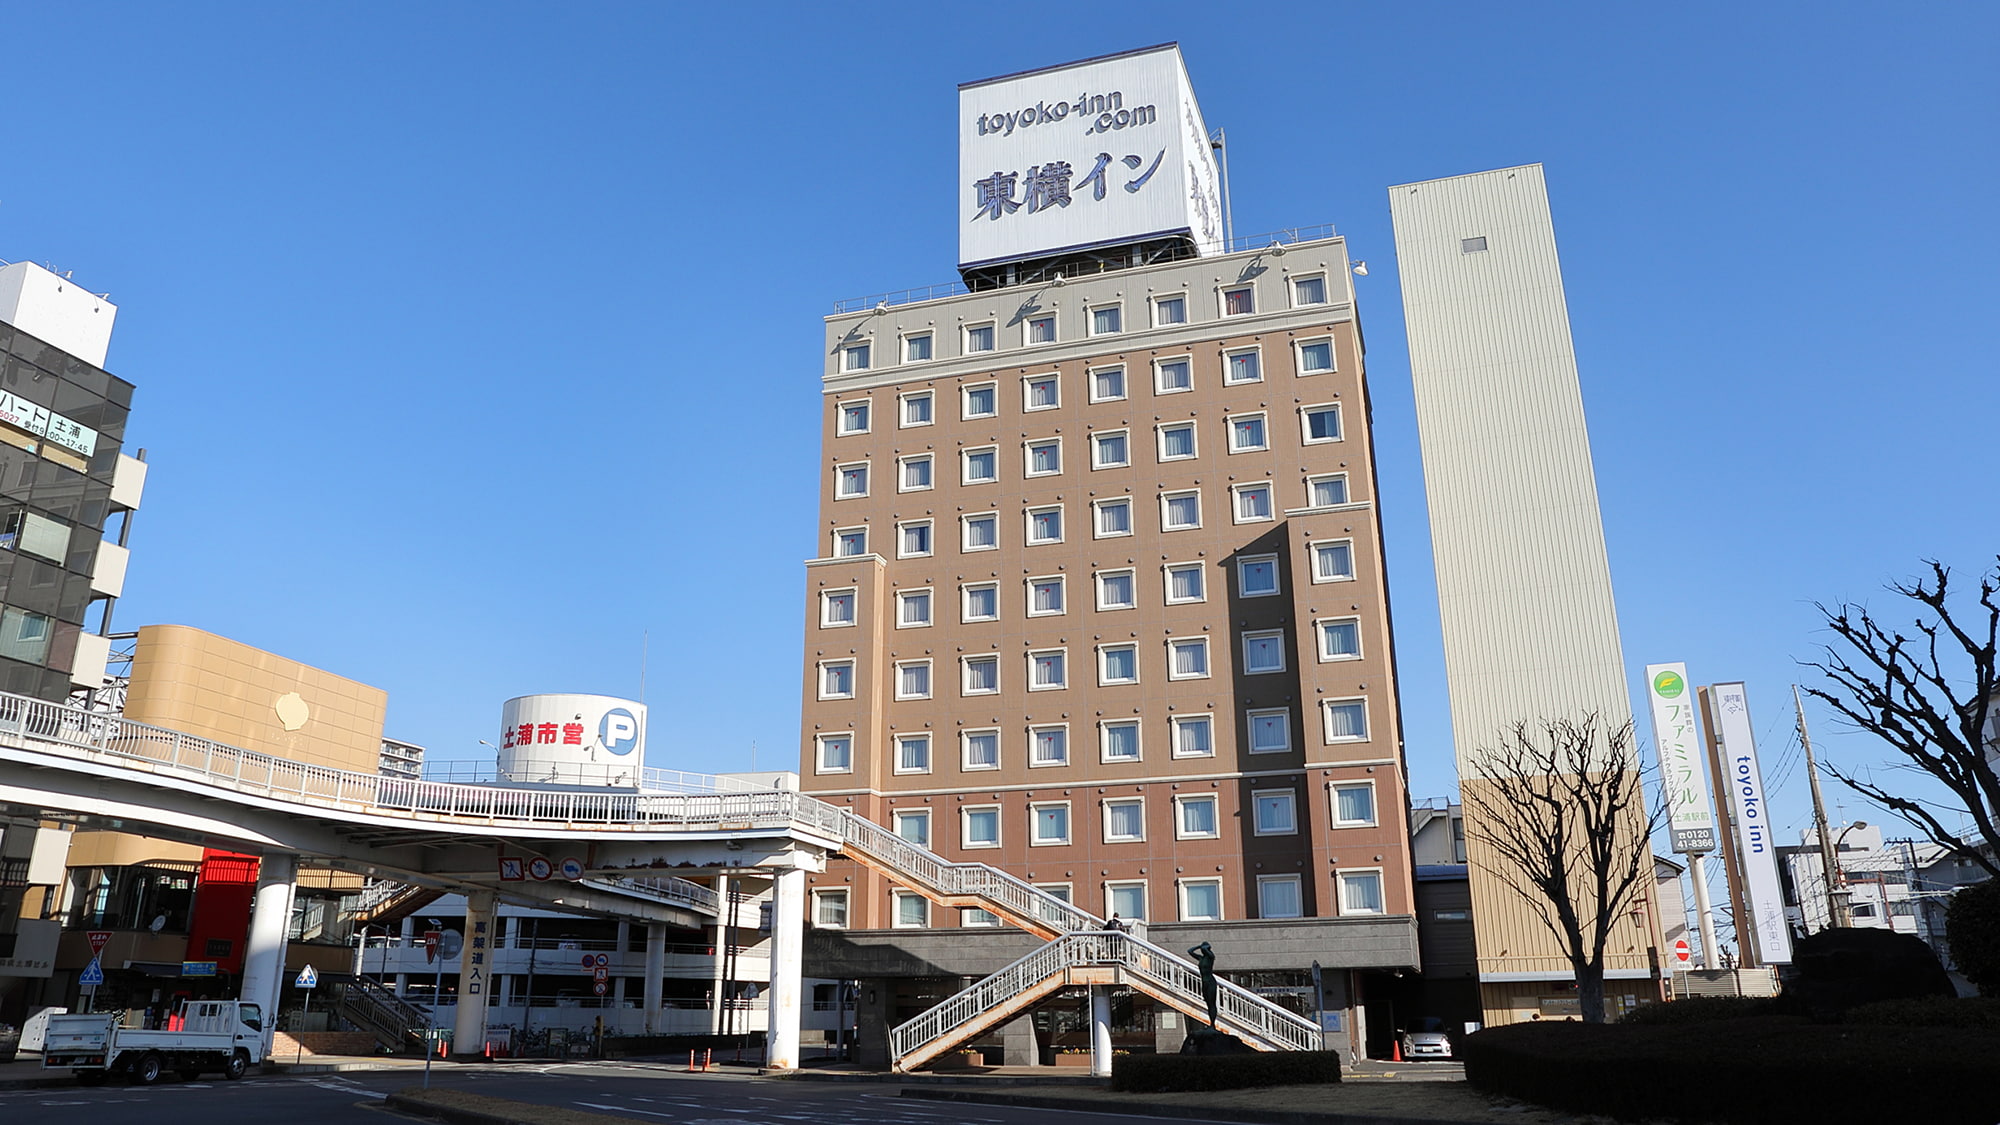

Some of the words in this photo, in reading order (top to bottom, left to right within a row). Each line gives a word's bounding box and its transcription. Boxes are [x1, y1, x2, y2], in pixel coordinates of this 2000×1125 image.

[976, 90, 1123, 137] toyoko-inn
[1085, 103, 1157, 136] .com
[969, 145, 1167, 222] 東横イン
[54, 419, 81, 439] 土浦
[503, 722, 584, 749] 土浦市営
[1665, 704, 1698, 805] ファミラル
[1737, 755, 1759, 819] toyoko
[1749, 825, 1764, 853] inn
[1677, 838, 1714, 848] 41-8366
[469, 921, 487, 994] 高架道入口
